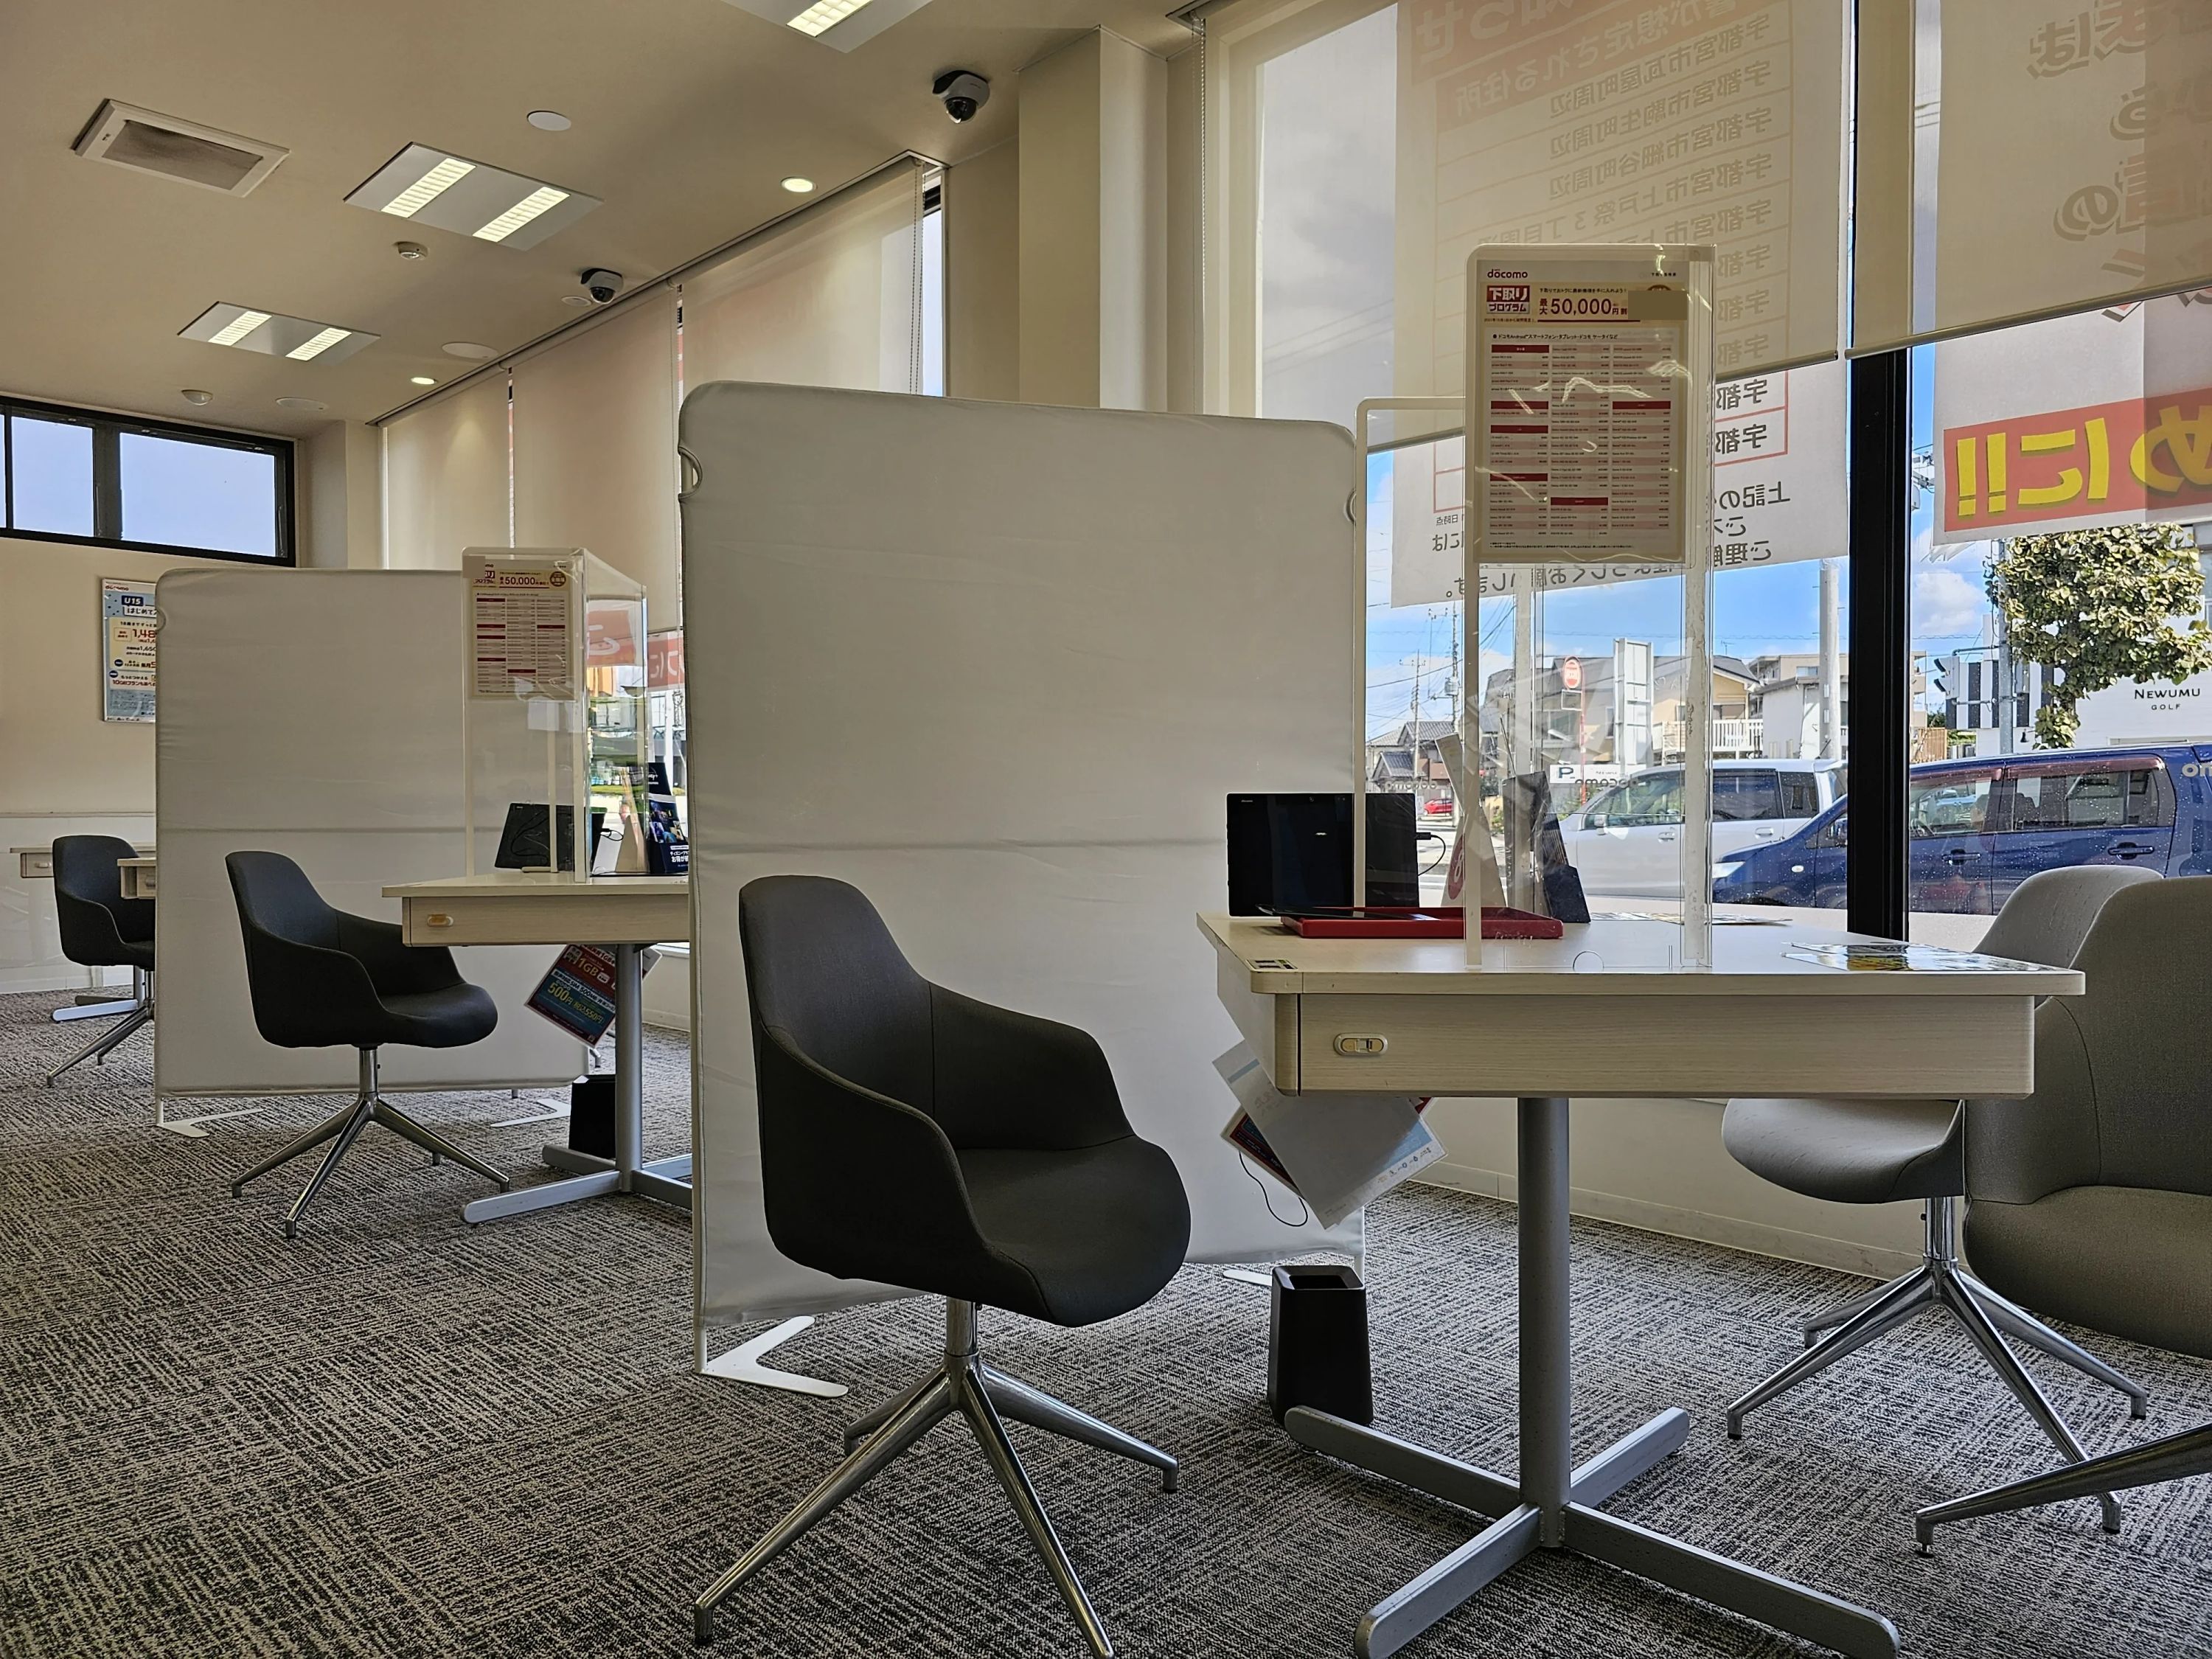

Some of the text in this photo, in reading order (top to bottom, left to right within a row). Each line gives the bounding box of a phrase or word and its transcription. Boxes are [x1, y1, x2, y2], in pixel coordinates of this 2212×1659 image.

[1487, 269, 1528, 279] docomo
[1489, 287, 1528, 301] 下取り
[1489, 303, 1526, 312] プログラム
